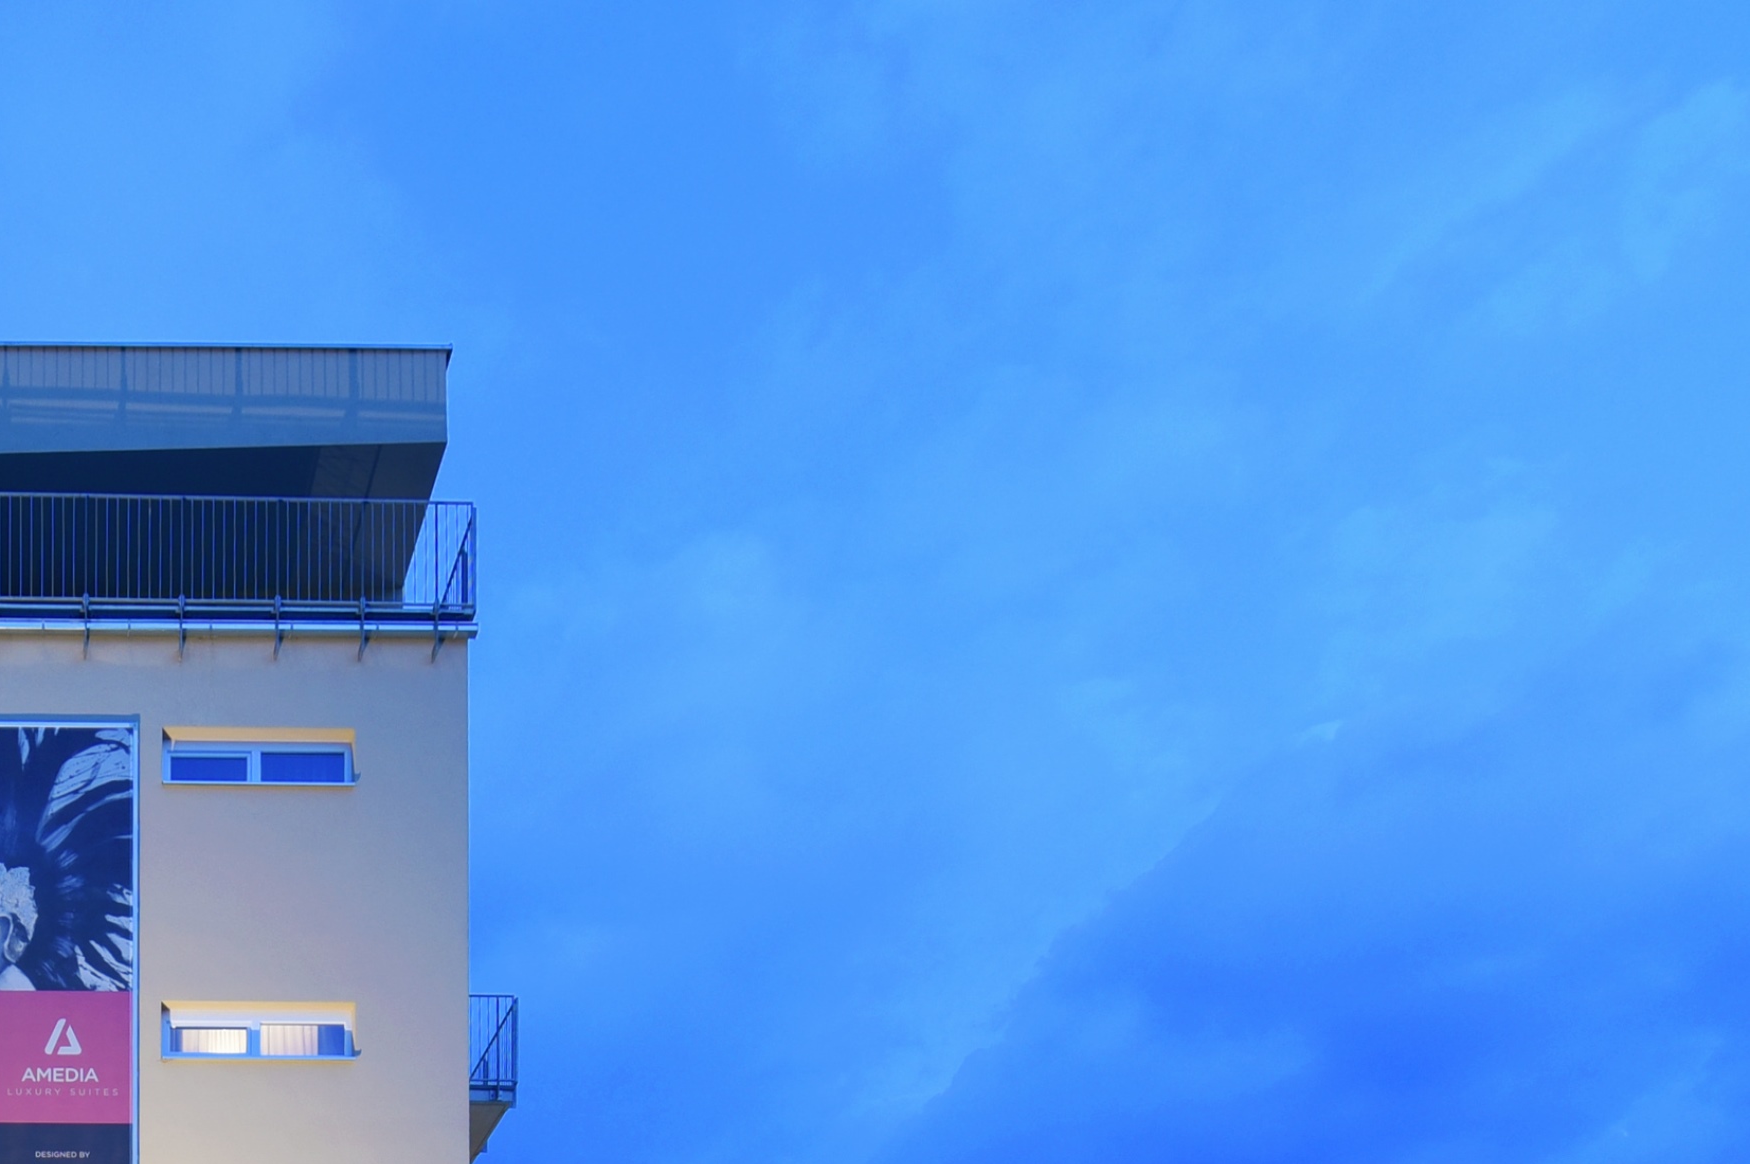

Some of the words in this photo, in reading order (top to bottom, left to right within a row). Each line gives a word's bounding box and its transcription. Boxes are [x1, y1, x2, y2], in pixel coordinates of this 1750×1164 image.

[21, 1067, 99, 1082] AMEDIA
[7, 1088, 61, 1096] LUXURY
[70, 1088, 119, 1096] SUITES
